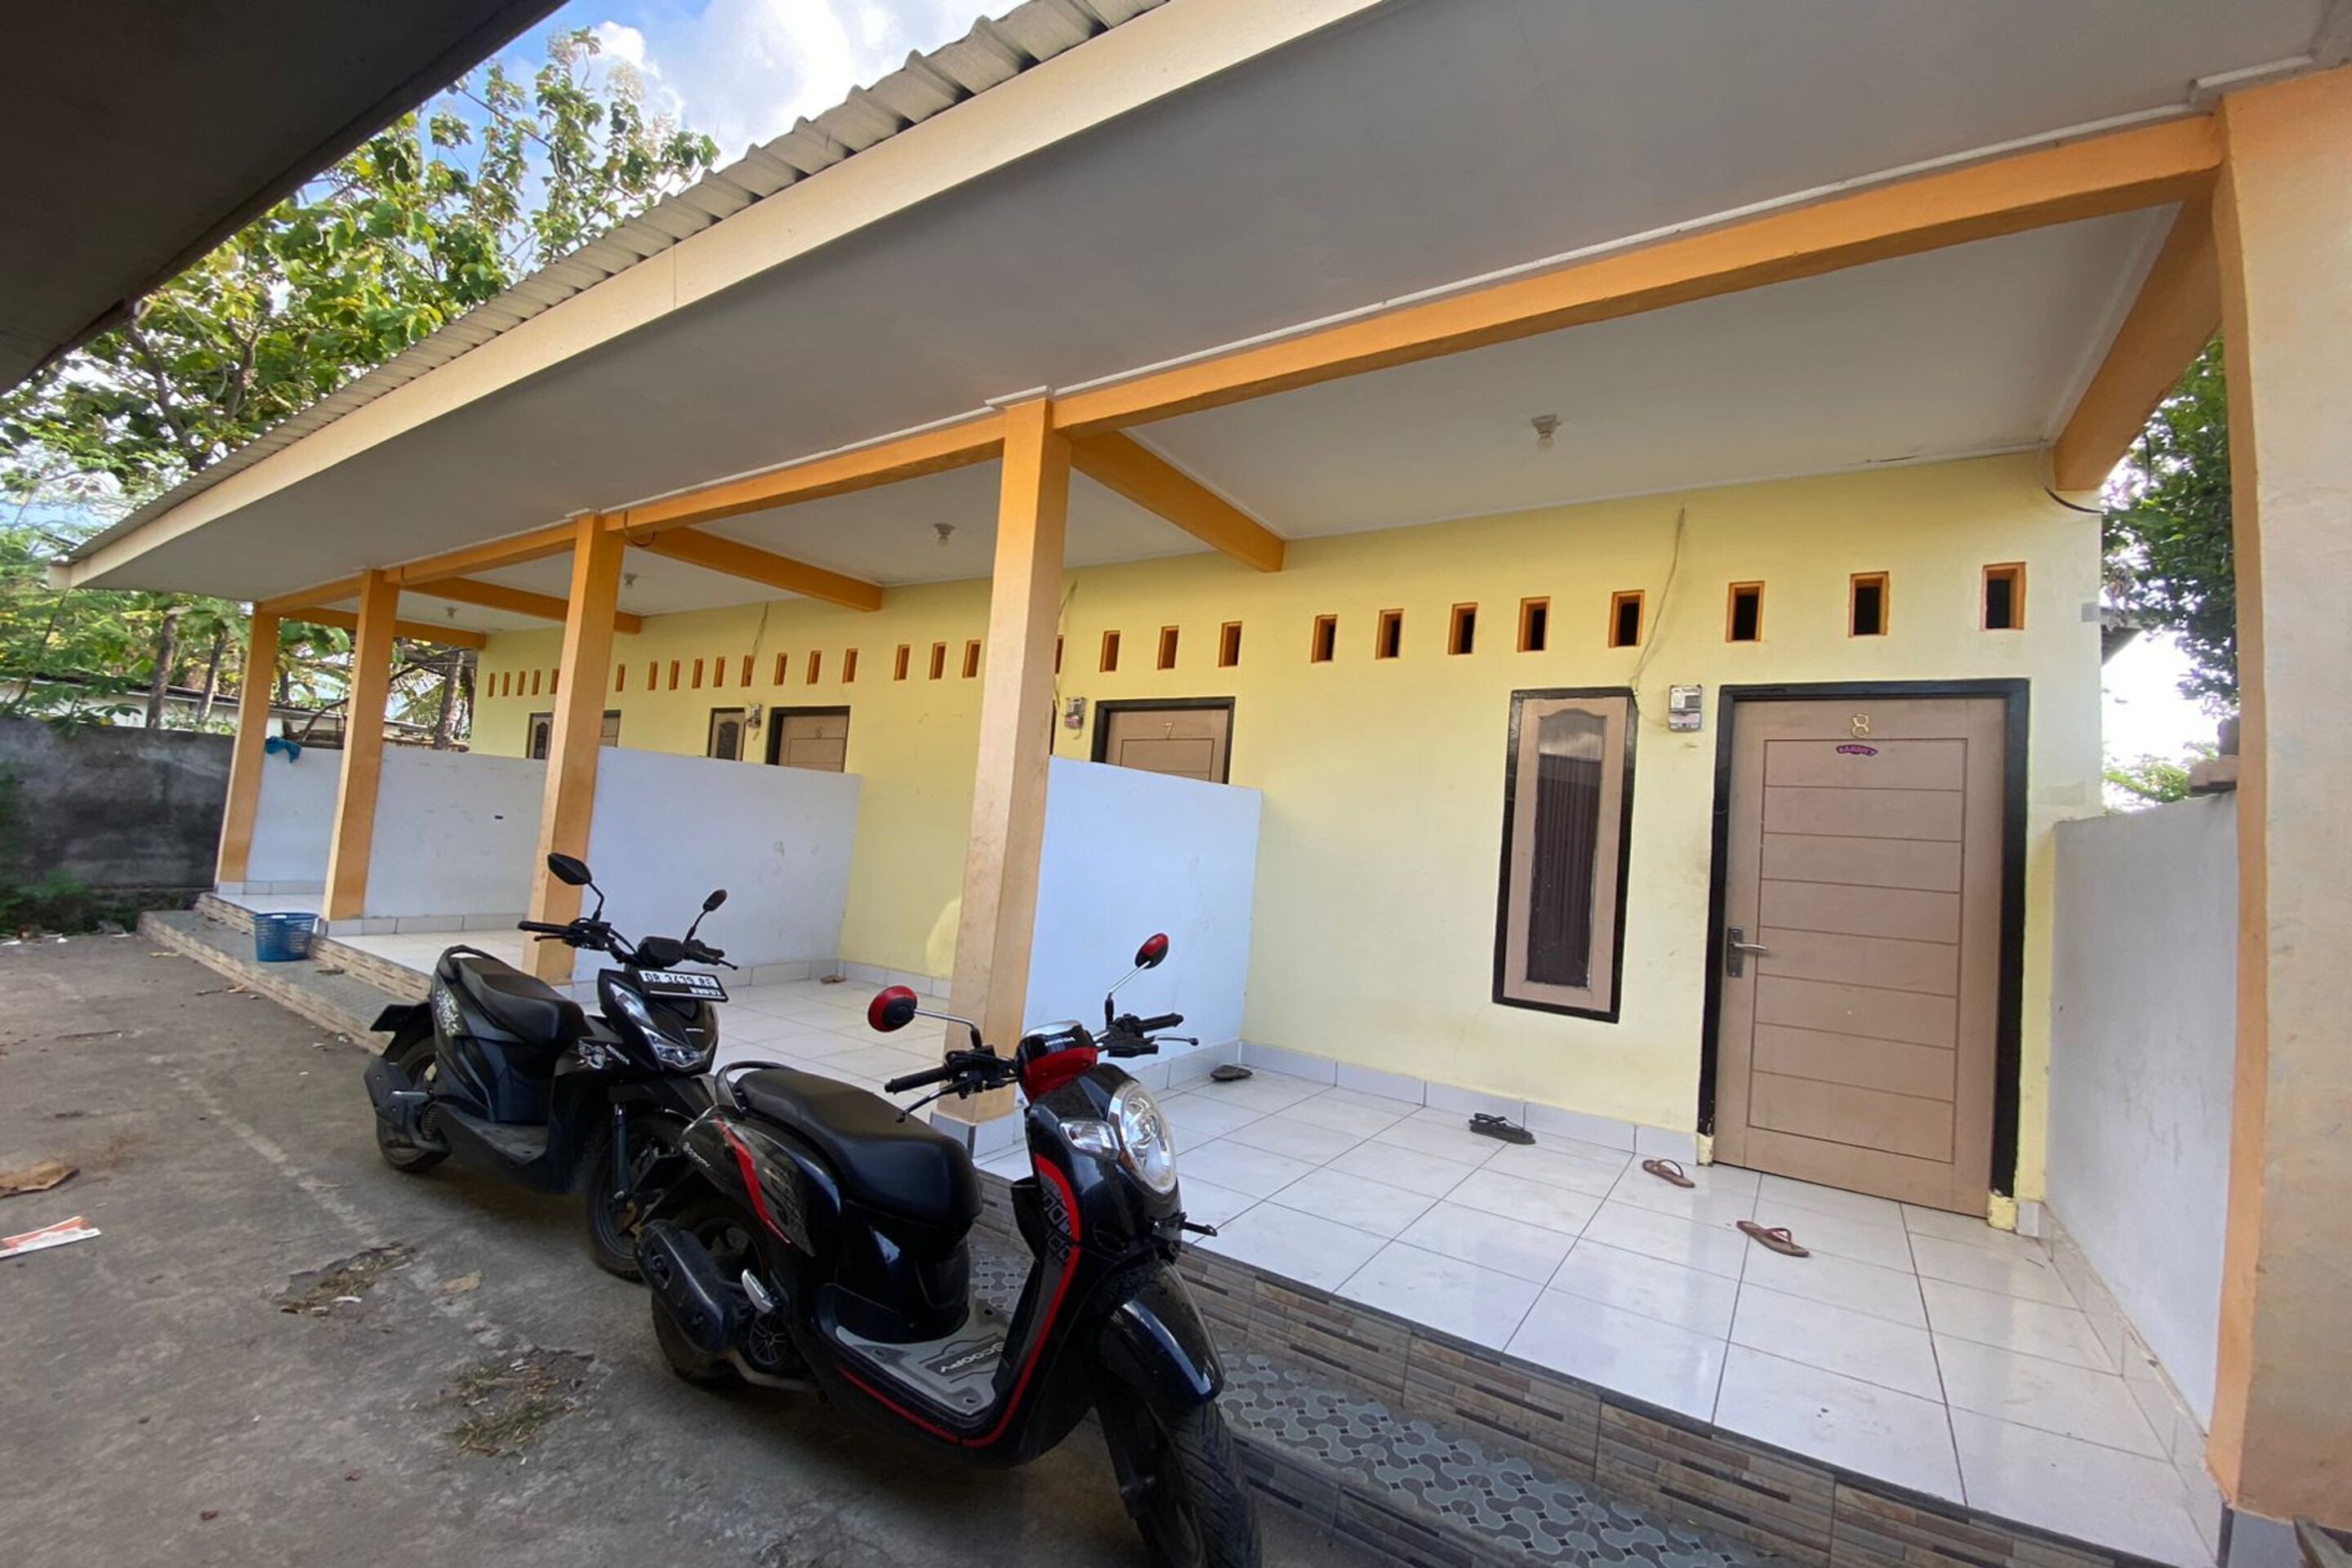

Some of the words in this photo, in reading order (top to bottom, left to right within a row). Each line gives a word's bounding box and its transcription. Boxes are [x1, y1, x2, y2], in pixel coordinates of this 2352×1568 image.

[1164, 720, 1175, 740] 7
[1851, 713, 1869, 738] 8
[1045, 1036, 1076, 1046] HONDA
[605, 1044, 630, 1065] HONDA
